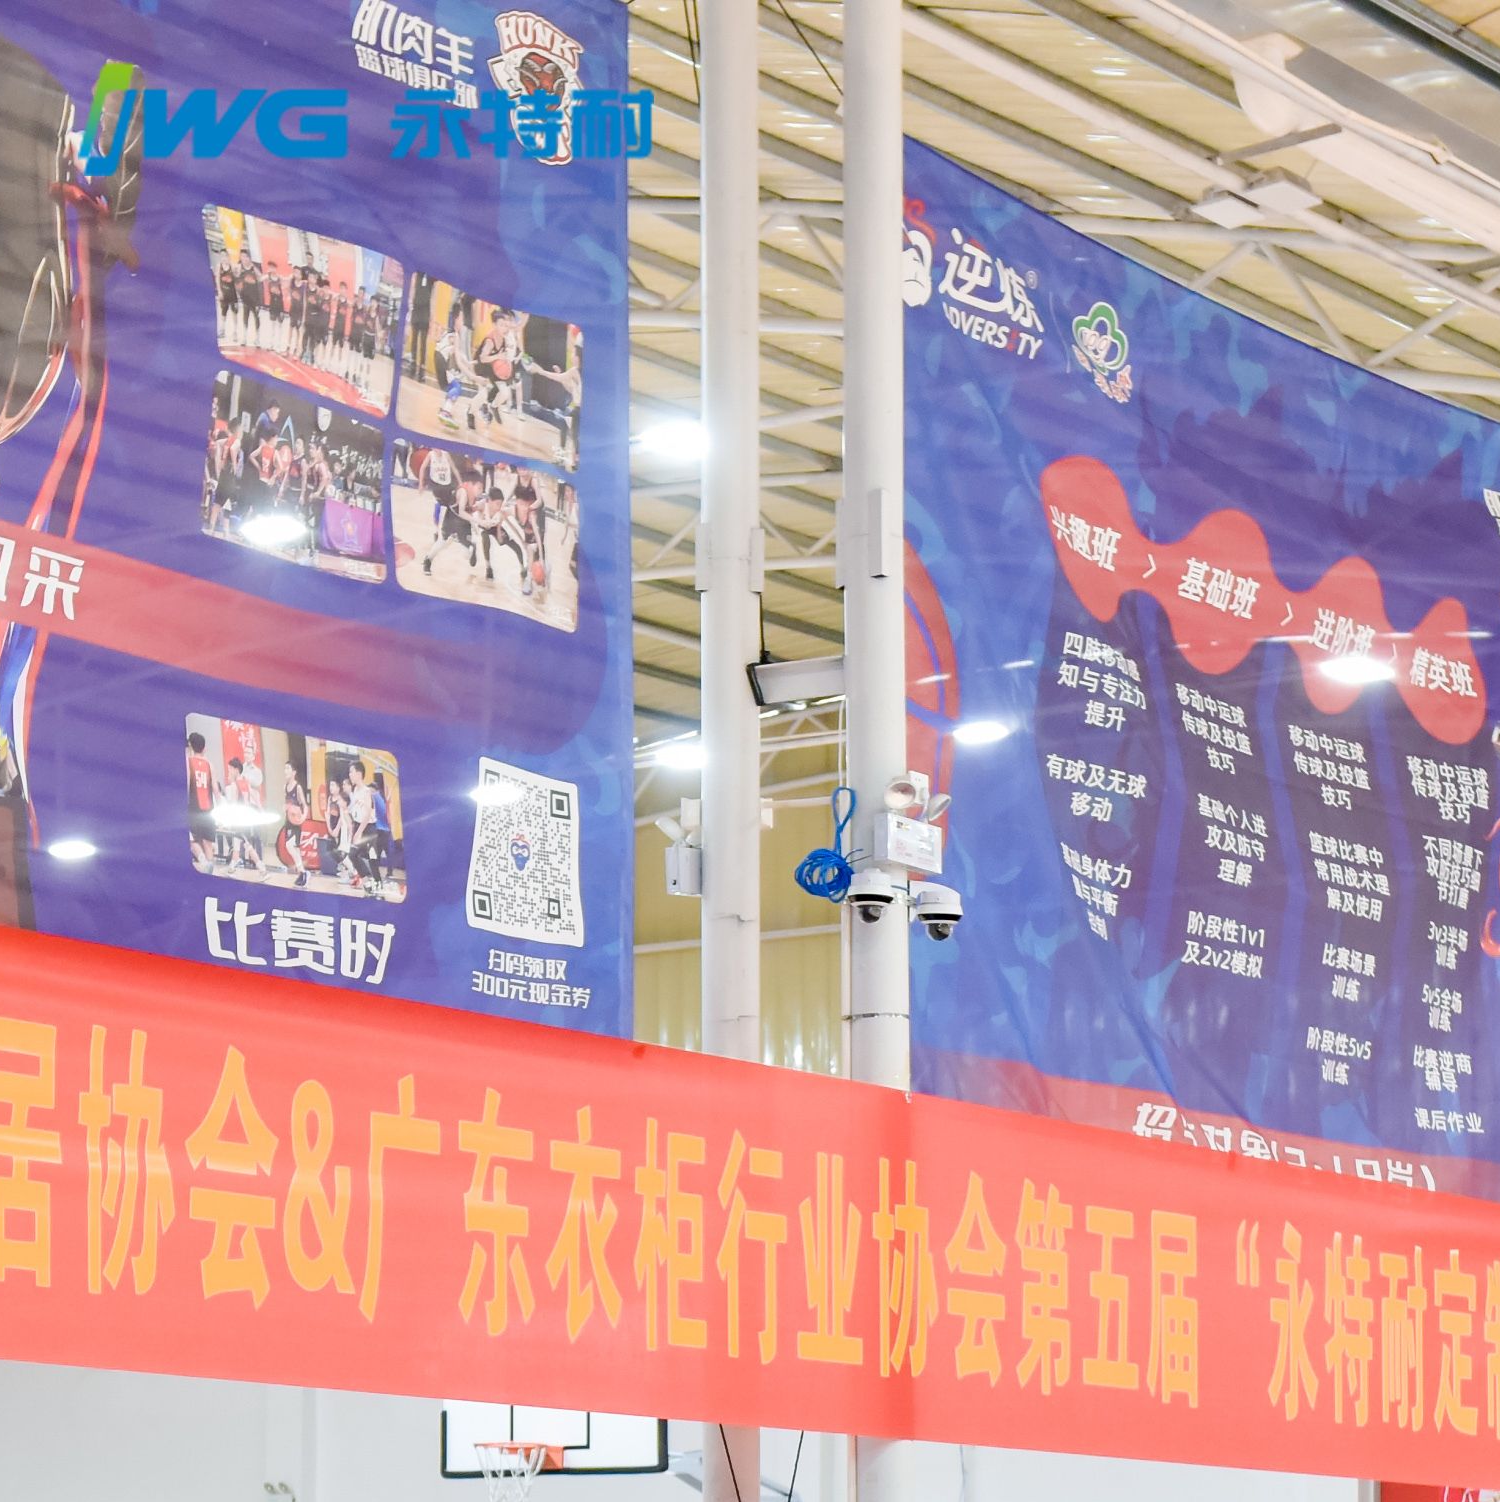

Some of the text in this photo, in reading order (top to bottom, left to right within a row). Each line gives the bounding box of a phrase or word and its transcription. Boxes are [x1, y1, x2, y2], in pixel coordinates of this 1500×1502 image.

[500, 14, 582, 68] HUNK
[1049, 504, 1122, 572] 兴趣班
[1177, 557, 1261, 620] 基础班
[1056, 661, 1147, 711] 知与专注力
[1410, 646, 1478, 698] 精英班
[1083, 699, 1128, 732] 提升
[1175, 682, 1248, 729] 移动中运球
[1181, 709, 1254, 756] 传球及投篮
[1287, 723, 1367, 765] 移动中运球
[1045, 753, 1148, 799] 有球及无球
[1205, 745, 1237, 775] 技巧
[1293, 751, 1372, 791] 传球及投篮
[1406, 755, 1489, 790] 移动中运球
[1069, 791, 1113, 823] 移动
[1320, 783, 1352, 811] 技巧
[1438, 799, 1471, 825] 技巧
[1204, 824, 1267, 863] 攻及防守
[1308, 830, 1385, 870] 篮球比赛中
[1216, 857, 1253, 888] 理解
[1313, 858, 1392, 897] 常用战术理
[1326, 886, 1383, 923] 解及使用
[203, 896, 396, 985] 比赛时
[1187, 910, 1266, 948] 阶段性1v1
[1427, 921, 1468, 953] 3v3半场
[488, 948, 568, 981] 扫码领取
[1181, 939, 1263, 980] 及2v2模拟
[1321, 942, 1377, 978] 比赛场景
[1434, 945, 1458, 971] 训练
[471, 969, 592, 1010] 300元现金券
[1331, 973, 1361, 1003] 训练
[1421, 983, 1463, 1015] 5v5全场
[1428, 1007, 1452, 1033] 训练
[1306, 1026, 1372, 1061] 阶段性5v5
[1321, 1058, 1350, 1086] 训练
[1414, 1107, 1485, 1135] 课后作业
